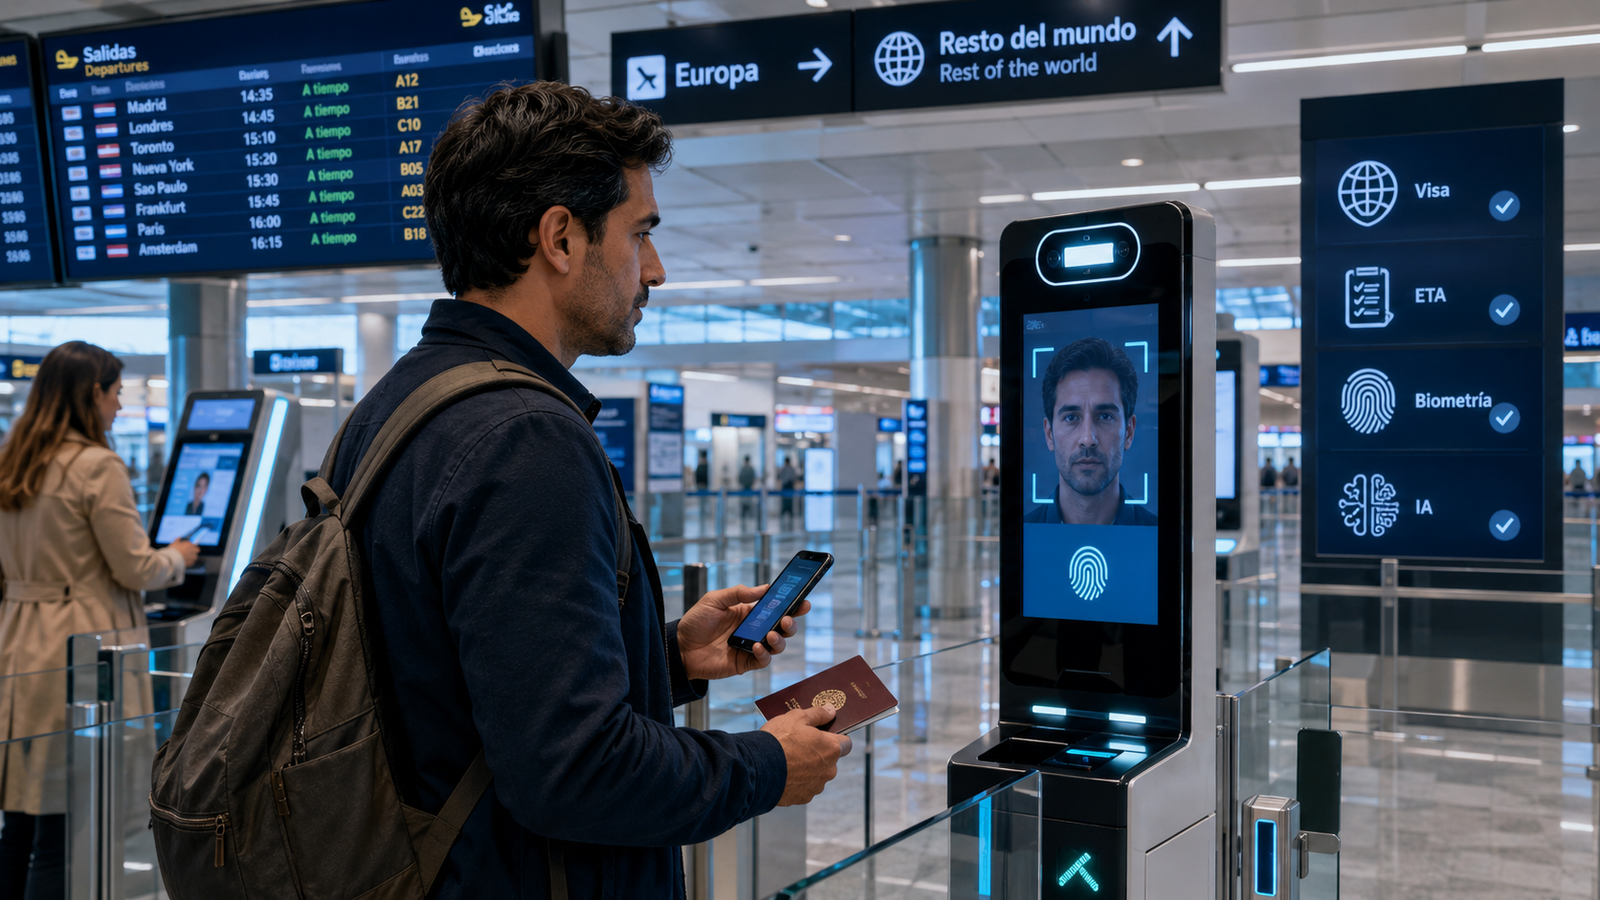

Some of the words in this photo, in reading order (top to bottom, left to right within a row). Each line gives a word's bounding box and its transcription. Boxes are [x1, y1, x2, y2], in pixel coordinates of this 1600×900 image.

[940, 30, 1004, 55] Resto
[1010, 23, 1046, 49] del
[1053, 16, 1137, 46] mundo
[83, 43, 136, 63] Salidas
[85, 61, 149, 78] Departures
[940, 63, 979, 82] Rest
[984, 59, 1004, 80] of
[1008, 58, 1039, 77] the
[1044, 52, 1098, 75] world
[395, 72, 419, 88] A12
[675, 62, 759, 90] Europa
[240, 87, 274, 103] 14:35
[302, 83, 312, 96] A
[313, 82, 350, 96] tiempo
[126, 97, 168, 115] Madrid
[303, 105, 313, 118] A
[314, 103, 350, 118] tiempo
[396, 95, 419, 110] B21
[241, 108, 275, 125] 14:45
[397, 117, 421, 132] C10
[128, 118, 175, 135] Londres
[304, 127, 314, 140] A
[315, 125, 352, 140] tiempo
[243, 130, 277, 146] 15:10
[129, 140, 175, 156] Toronto
[306, 148, 315, 161] A
[316, 147, 353, 161] tiempo
[399, 139, 422, 154] A17
[131, 160, 168, 176] Nueva
[167, 157, 195, 173] York
[244, 151, 278, 167] 15:20
[307, 169, 316, 182] A
[318, 168, 354, 182] tiempo
[400, 161, 424, 176] B05
[133, 182, 156, 197] Sao
[156, 179, 188, 195] Paulo
[246, 172, 279, 188] 15:30
[308, 190, 318, 203] A
[319, 189, 355, 204] tiempo
[401, 183, 425, 197] A03
[1415, 182, 1449, 198] Visa
[135, 200, 187, 217] Frankfurt
[247, 193, 281, 209] 15:45
[309, 212, 319, 224] A
[320, 210, 356, 225] tiempo
[402, 205, 425, 219] C22
[249, 214, 282, 230] 16:00
[250, 234, 283, 250] 16:15
[311, 233, 320, 245] A
[321, 232, 357, 246] tiempo
[404, 227, 427, 241] B18
[138, 240, 199, 257] Amsterdam
[1415, 287, 1446, 303] ETA
[1415, 391, 1492, 408] Biometría
[1416, 499, 1433, 514] IA
